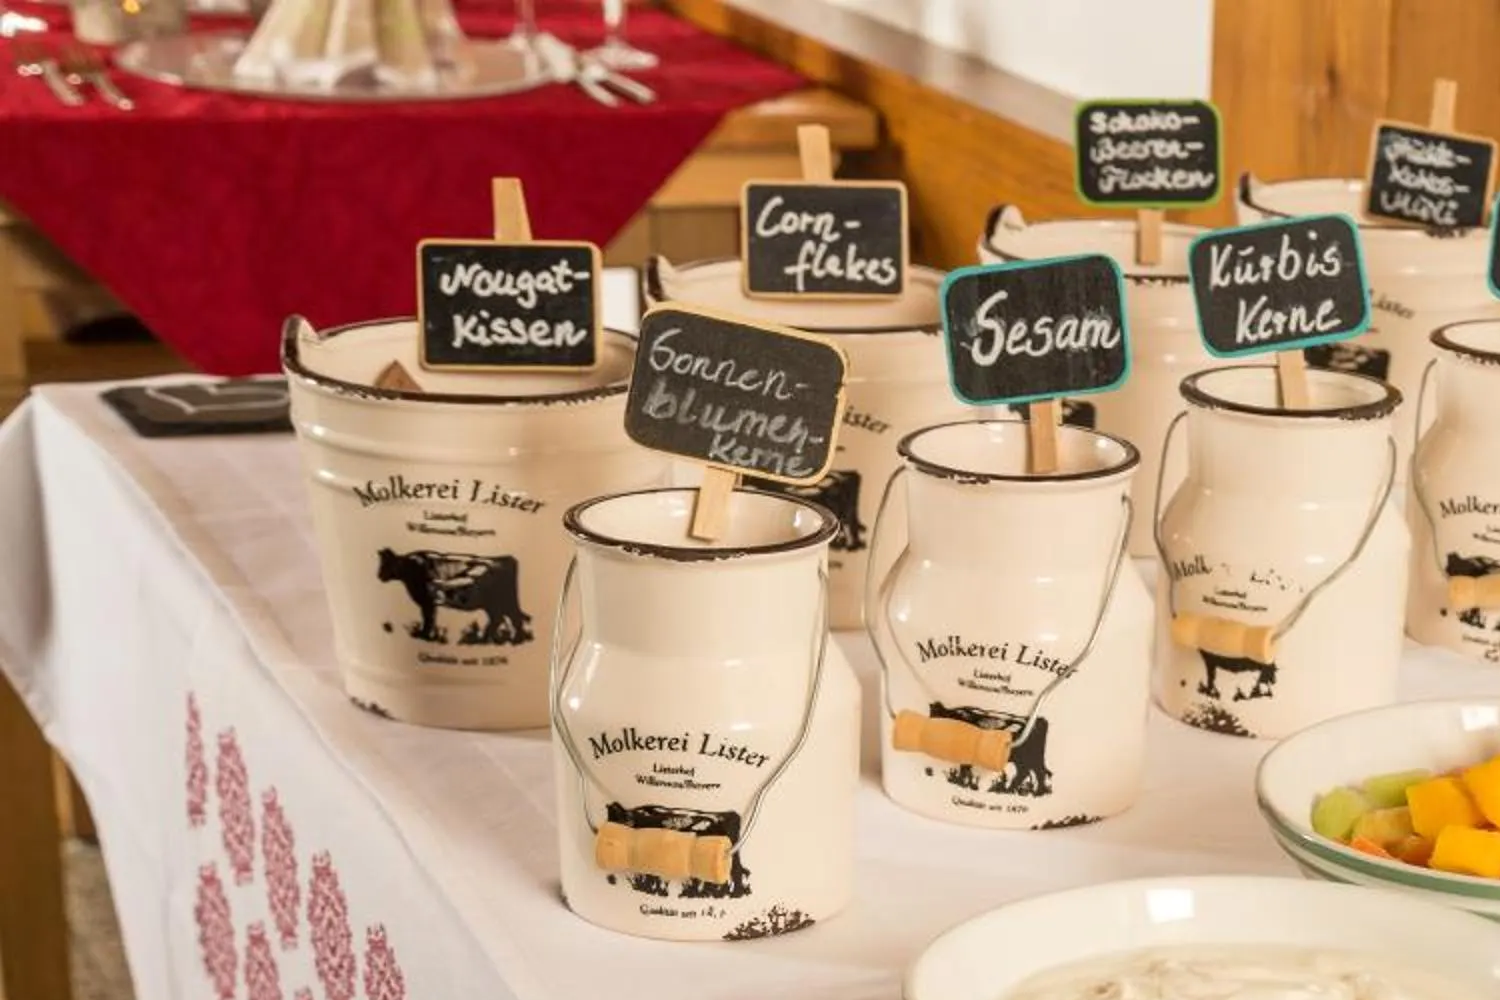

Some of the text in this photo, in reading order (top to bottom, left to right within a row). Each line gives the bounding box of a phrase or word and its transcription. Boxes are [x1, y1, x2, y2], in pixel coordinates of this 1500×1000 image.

[755, 196, 862, 242] Corn-
[439, 258, 591, 309] Nougat-
[783, 240, 897, 291] flakes
[970, 290, 1121, 367] Sesam
[1236, 295, 1342, 343] Kerne
[842, 406, 890, 434] ister
[353, 474, 459, 508] Molkerei
[915, 636, 1009, 664] Molkerei
[588, 728, 770, 768] Molkerei Lister
